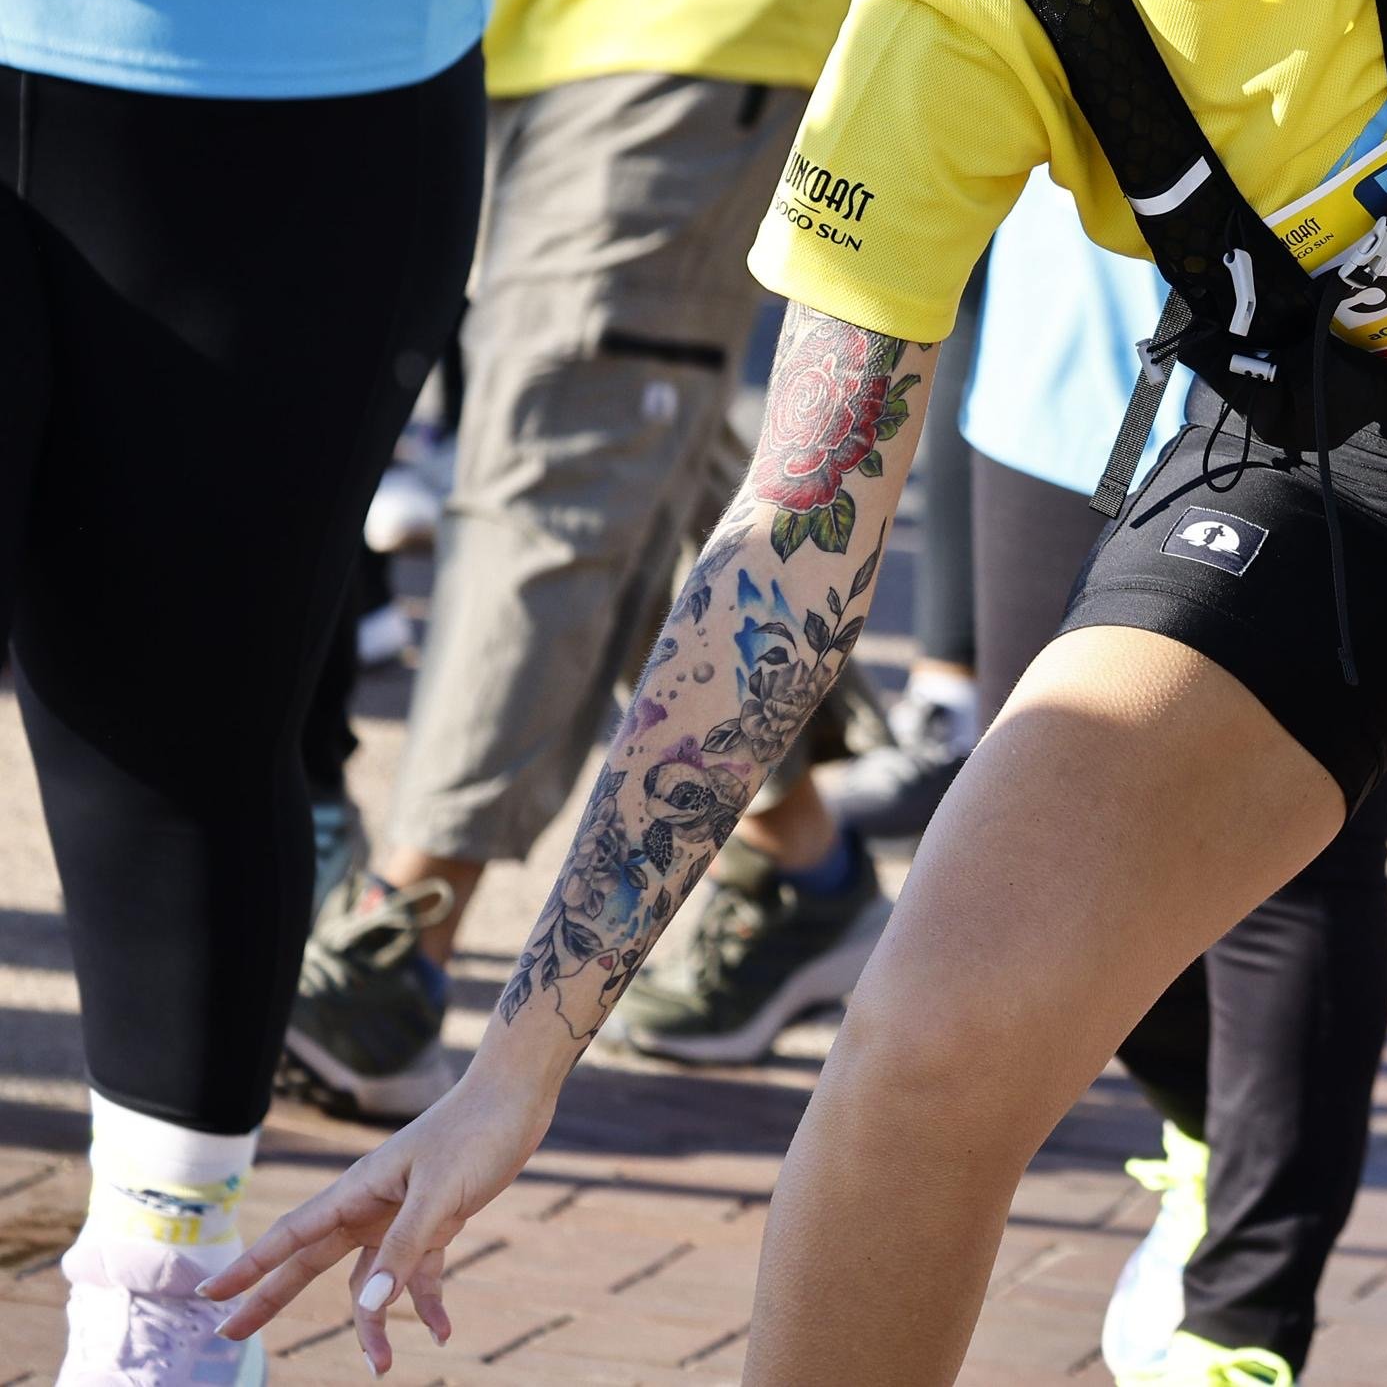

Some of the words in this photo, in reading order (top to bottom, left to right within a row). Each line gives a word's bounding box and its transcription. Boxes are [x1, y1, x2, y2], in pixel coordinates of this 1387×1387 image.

[785, 147, 875, 222] UNCOAST
[816, 223, 863, 252] SUN
[1280, 216, 1322, 250] COAST
[1314, 233, 1335, 250] SUN
